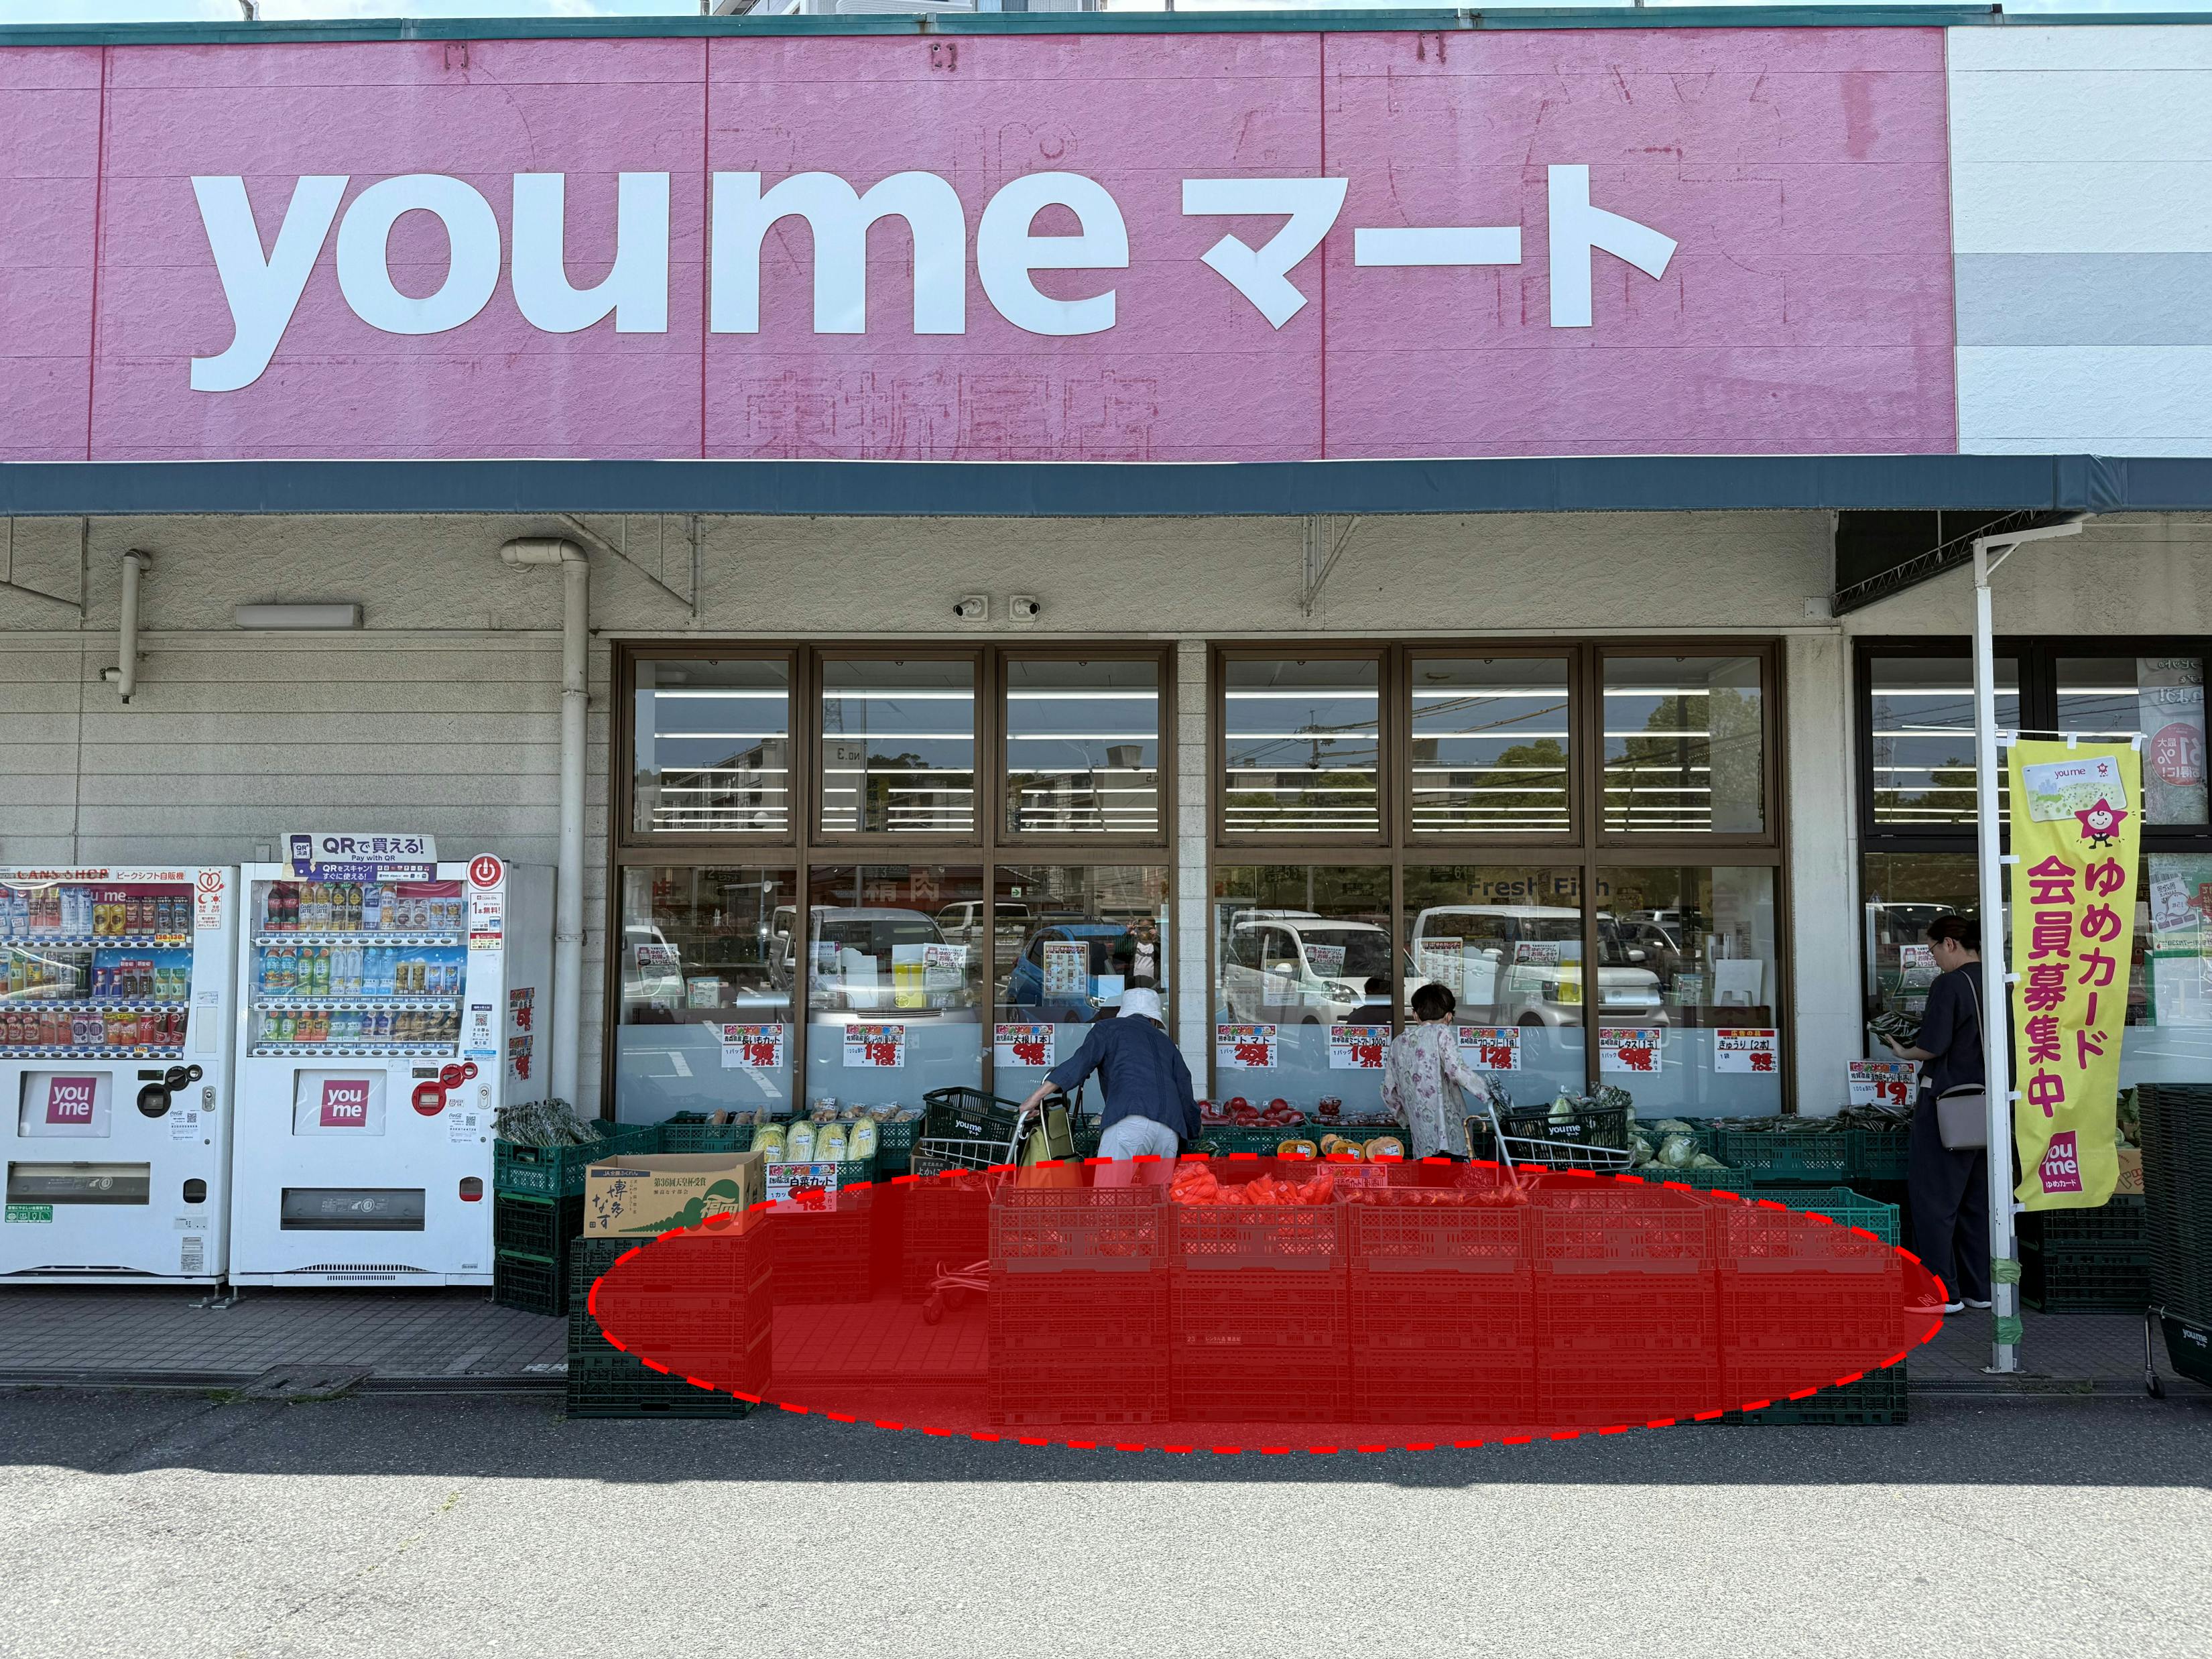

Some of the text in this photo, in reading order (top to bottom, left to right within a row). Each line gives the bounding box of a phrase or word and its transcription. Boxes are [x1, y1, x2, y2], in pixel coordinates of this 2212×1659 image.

[1182, 164, 1677, 329] マート
[322, 837, 424, 854] QRで買える!
[322, 864, 373, 872] QRをスキャン!
[1467, 877, 1609, 896] Fresh Fih
[2077, 857, 2126, 1070] ゆめカード
[2024, 855, 2076, 1117] 会員募集中
[742, 1036, 780, 1044] 長いもカット
[1240, 1036, 1270, 1044] トマト
[1719, 1040, 1746, 1050] きゅうり
[743, 1044, 774, 1060] 198
[1351, 1046, 1382, 1062] 198
[54, 1086, 89, 1104] you
[328, 1088, 361, 1105] you
[1875, 1081, 1908, 1101] 19
[58, 1102, 89, 1115] me
[332, 1103, 362, 1117] me
[2045, 1160, 2077, 1176] me
[654, 1177, 706, 1187] 第36回天皇杯受賞
[790, 1176, 833, 1186] 白菜カット
[2046, 1179, 2077, 1188] ゆめカード
[607, 1179, 628, 1218] 博多
[592, 1194, 611, 1229] なす
